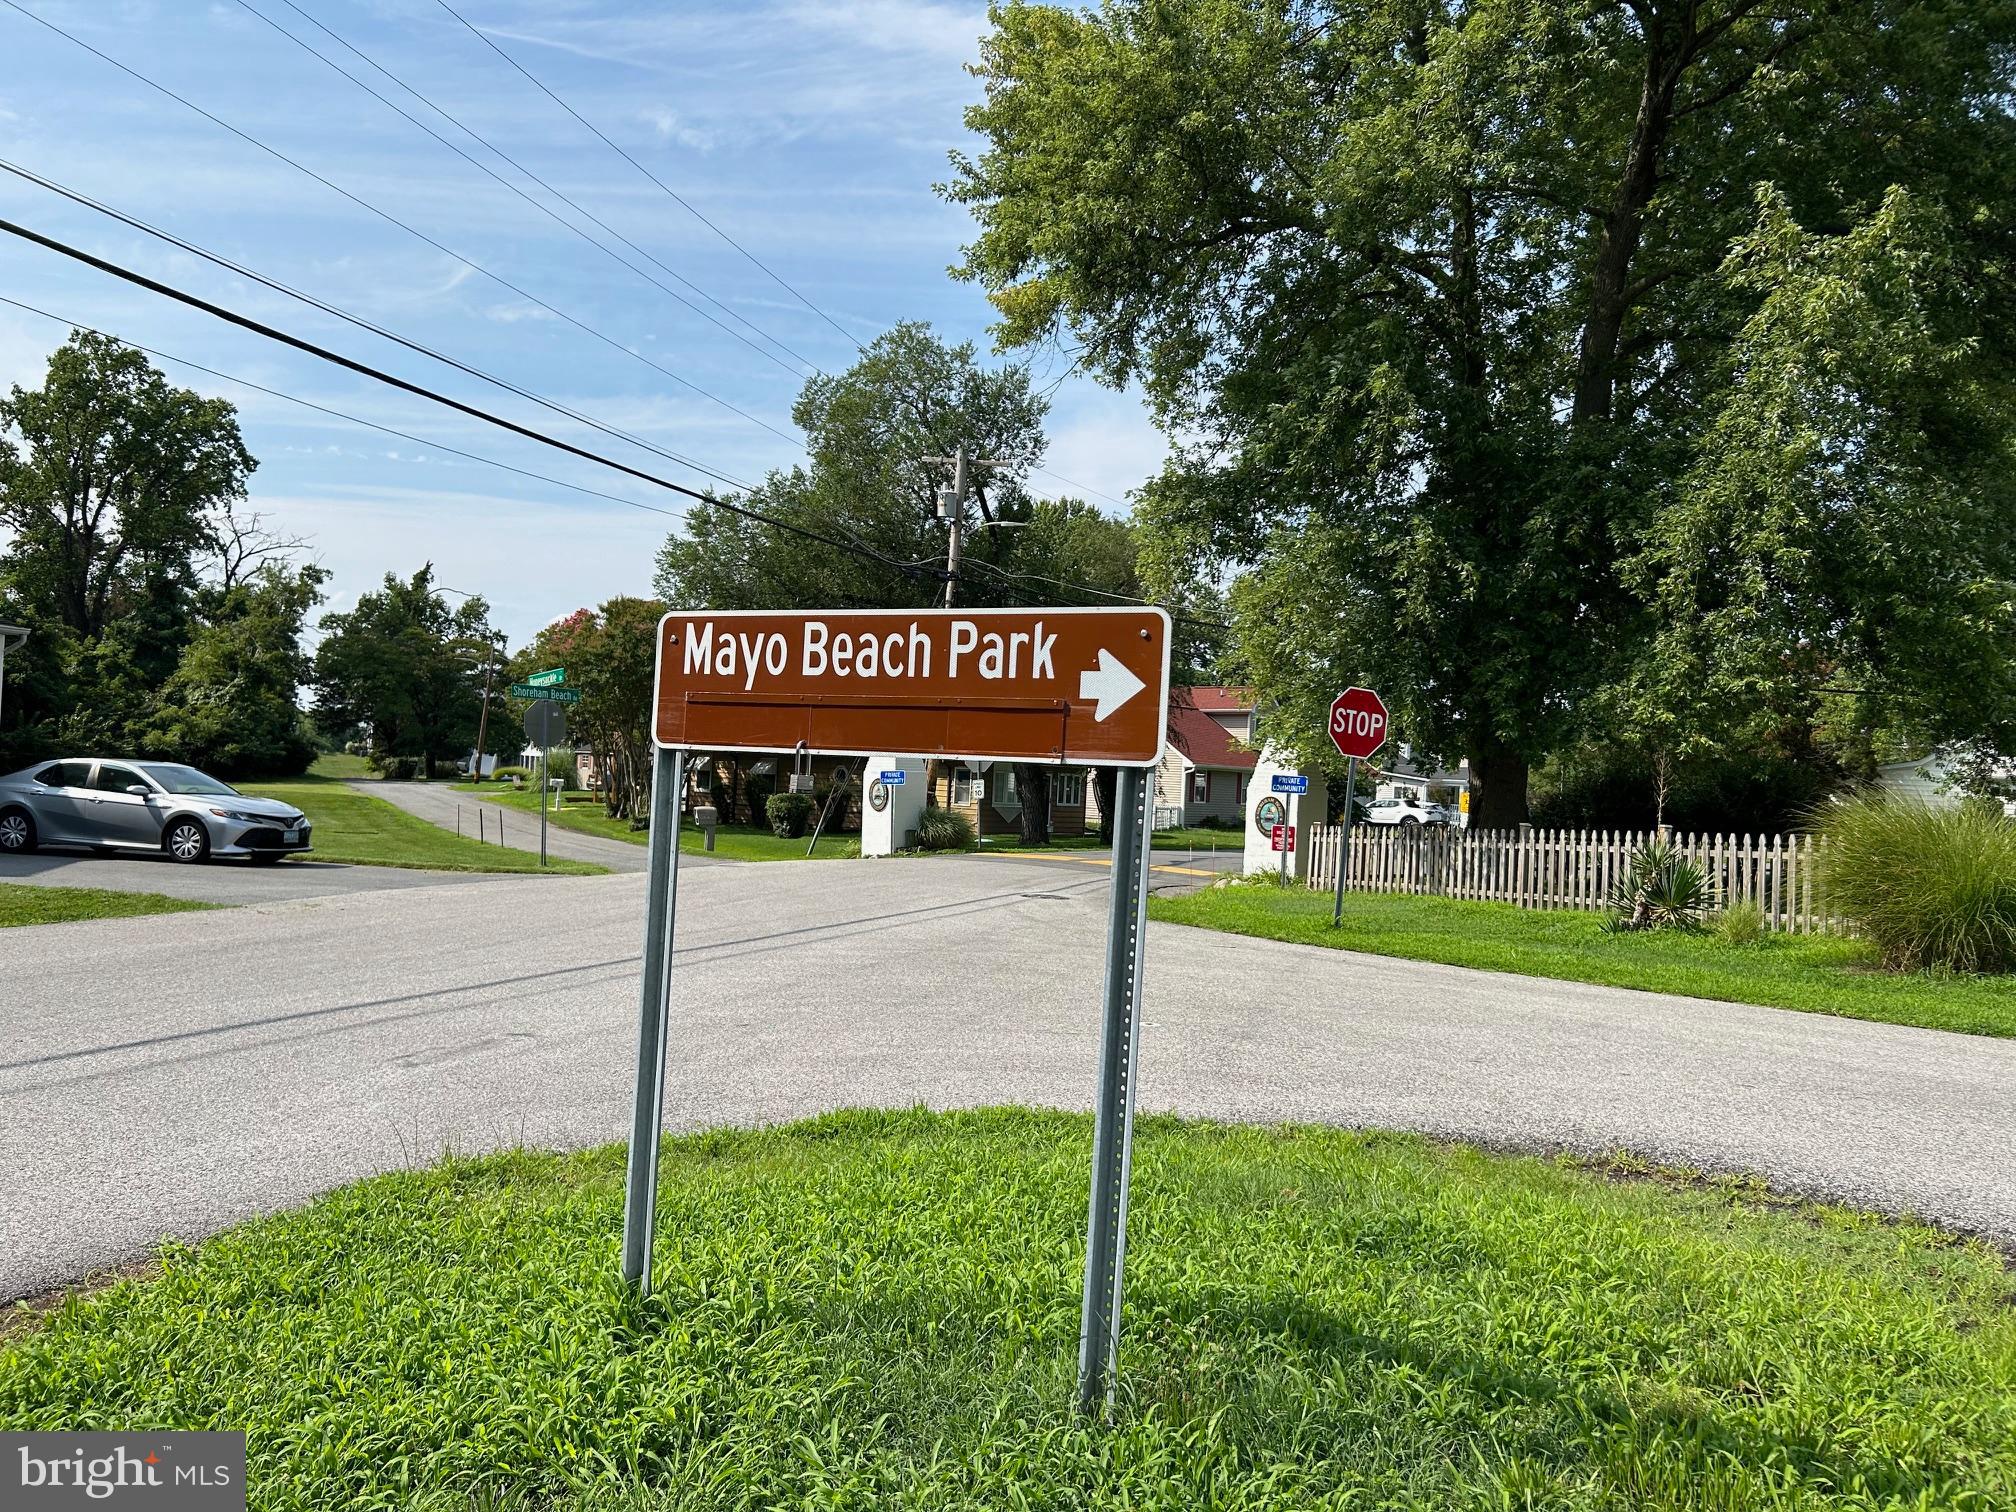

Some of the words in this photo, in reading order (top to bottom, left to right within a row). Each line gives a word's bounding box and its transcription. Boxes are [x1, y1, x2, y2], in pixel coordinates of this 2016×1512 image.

[683, 622, 788, 691] Mayo
[802, 621, 931, 678] Beach
[948, 621, 1059, 680] Park
[513, 685, 548, 698] Shoreham
[551, 689, 571, 700] Beach
[1333, 707, 1383, 737] STOP
[1278, 777, 1300, 785] PRIVATE
